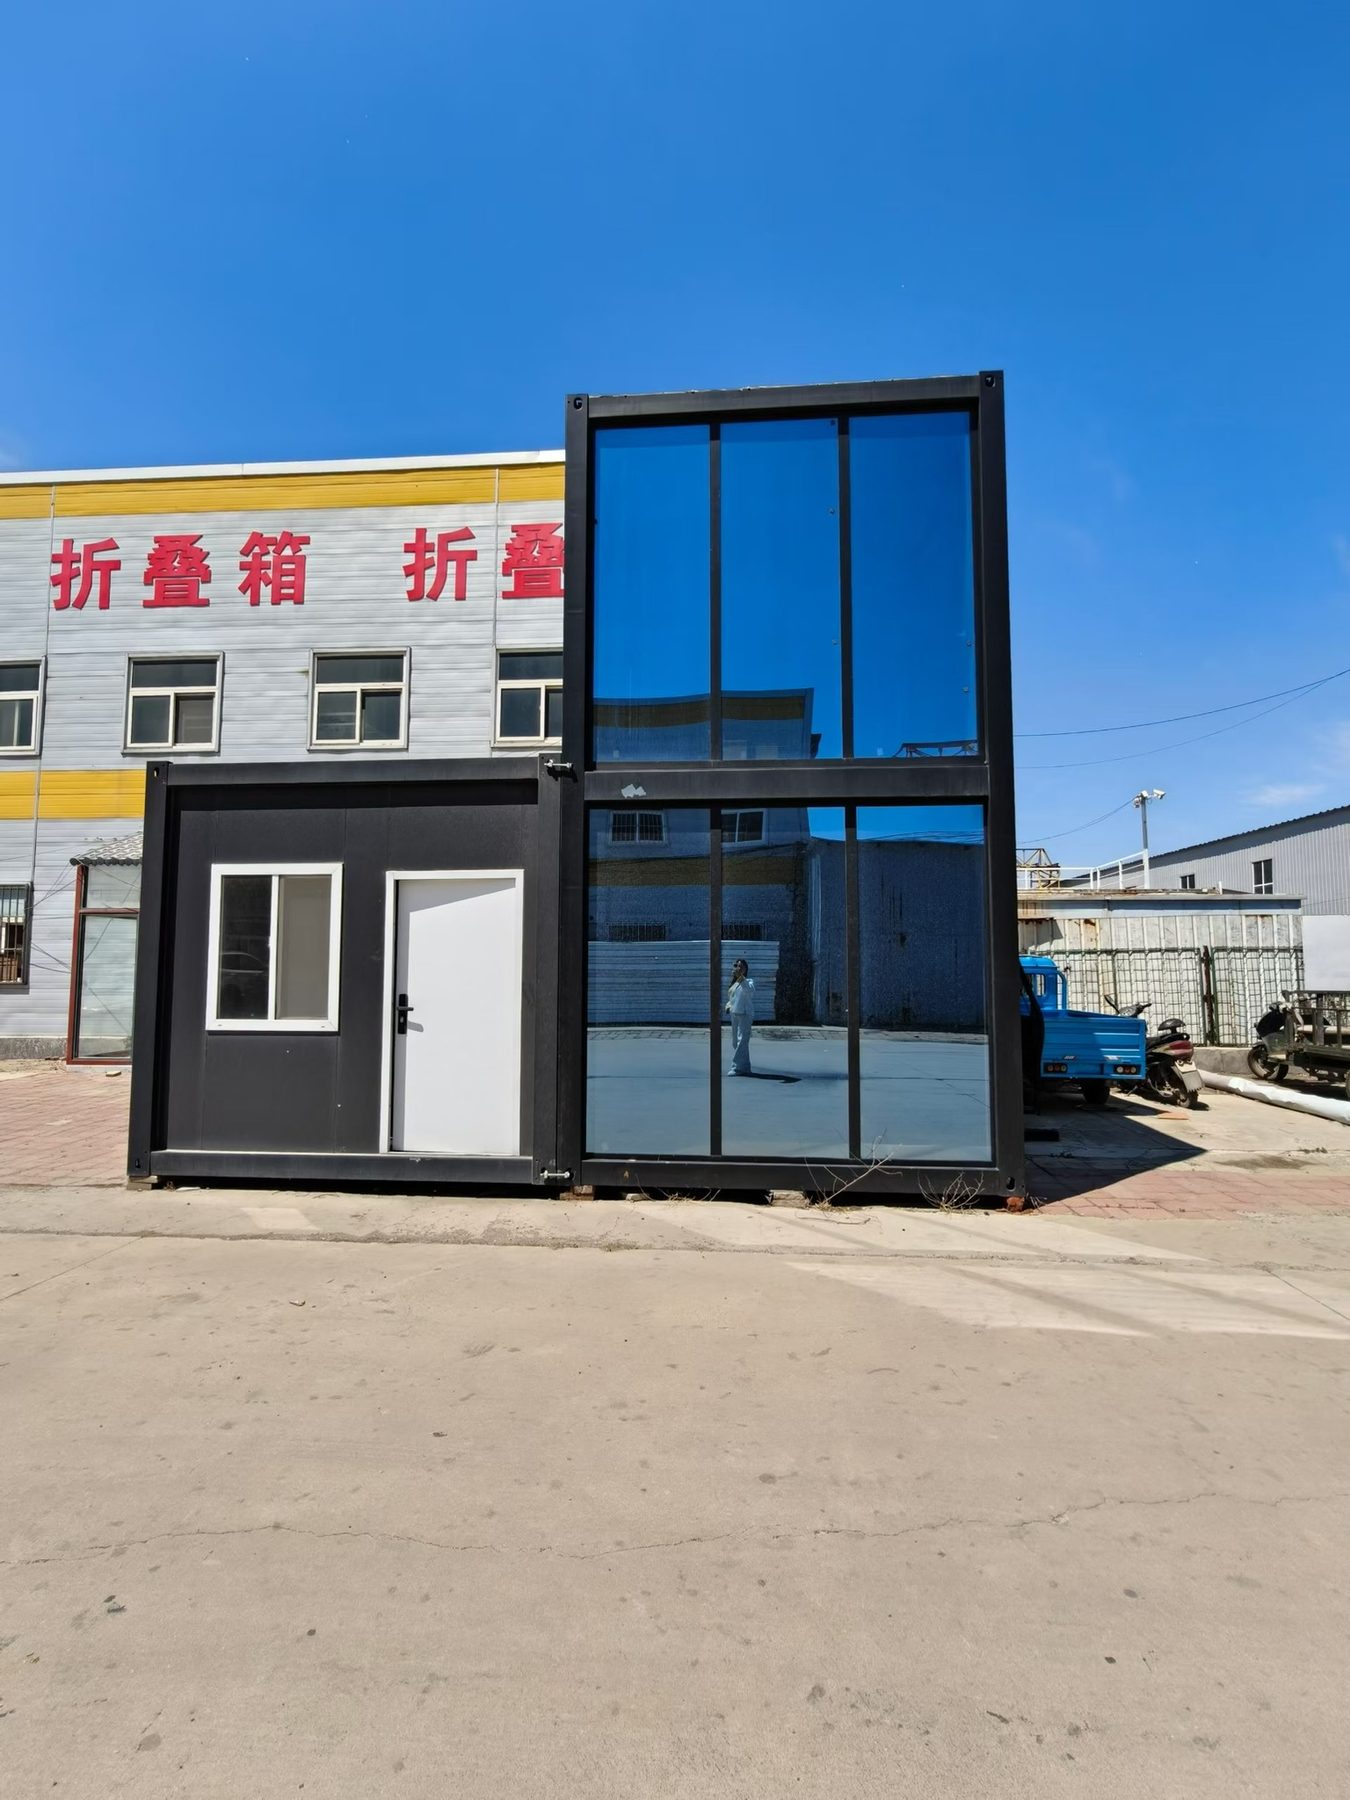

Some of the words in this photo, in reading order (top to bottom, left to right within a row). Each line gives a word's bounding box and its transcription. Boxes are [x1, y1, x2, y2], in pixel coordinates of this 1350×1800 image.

[50, 531, 310, 609] 折叠箱
[402, 522, 564, 601] 折叠
